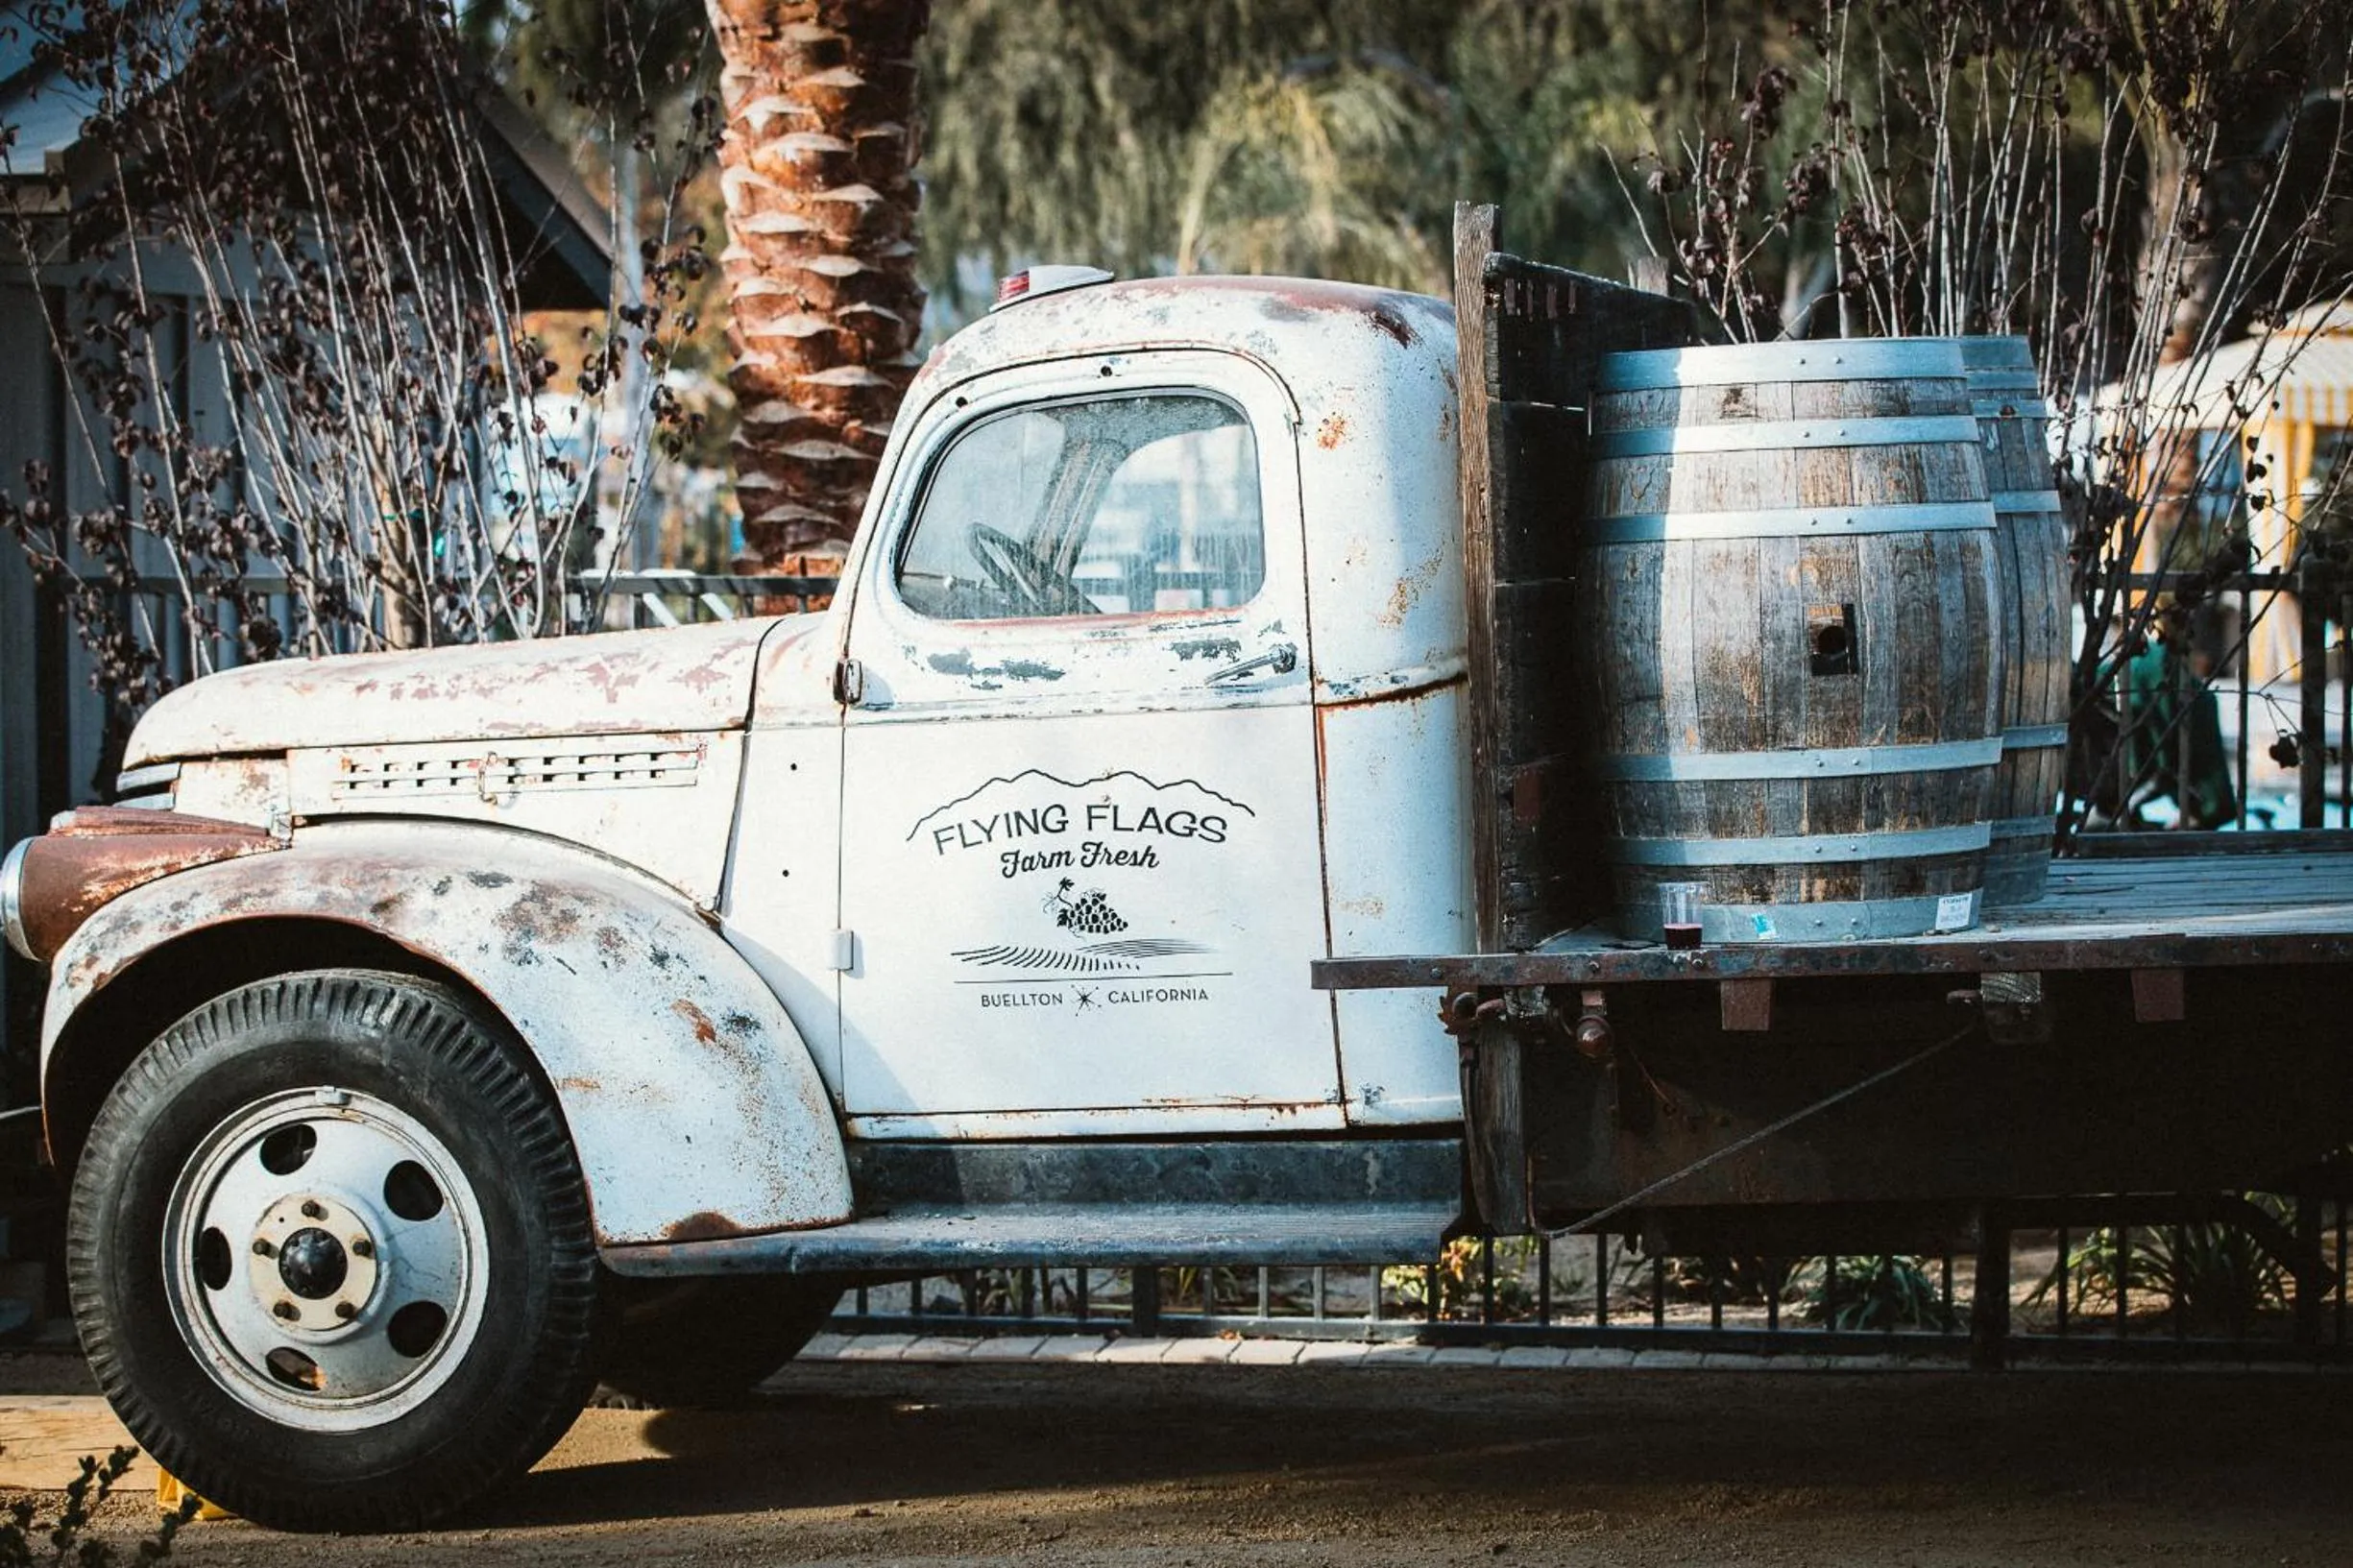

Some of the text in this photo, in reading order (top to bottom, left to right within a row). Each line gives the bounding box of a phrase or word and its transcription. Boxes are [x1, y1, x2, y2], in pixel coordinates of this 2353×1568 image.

[933, 804, 1228, 856] FLYING FLAGS
[1000, 841, 1160, 879] Farm Fresh
[981, 988, 1209, 1007] BUELLTON CALIFORNIA
